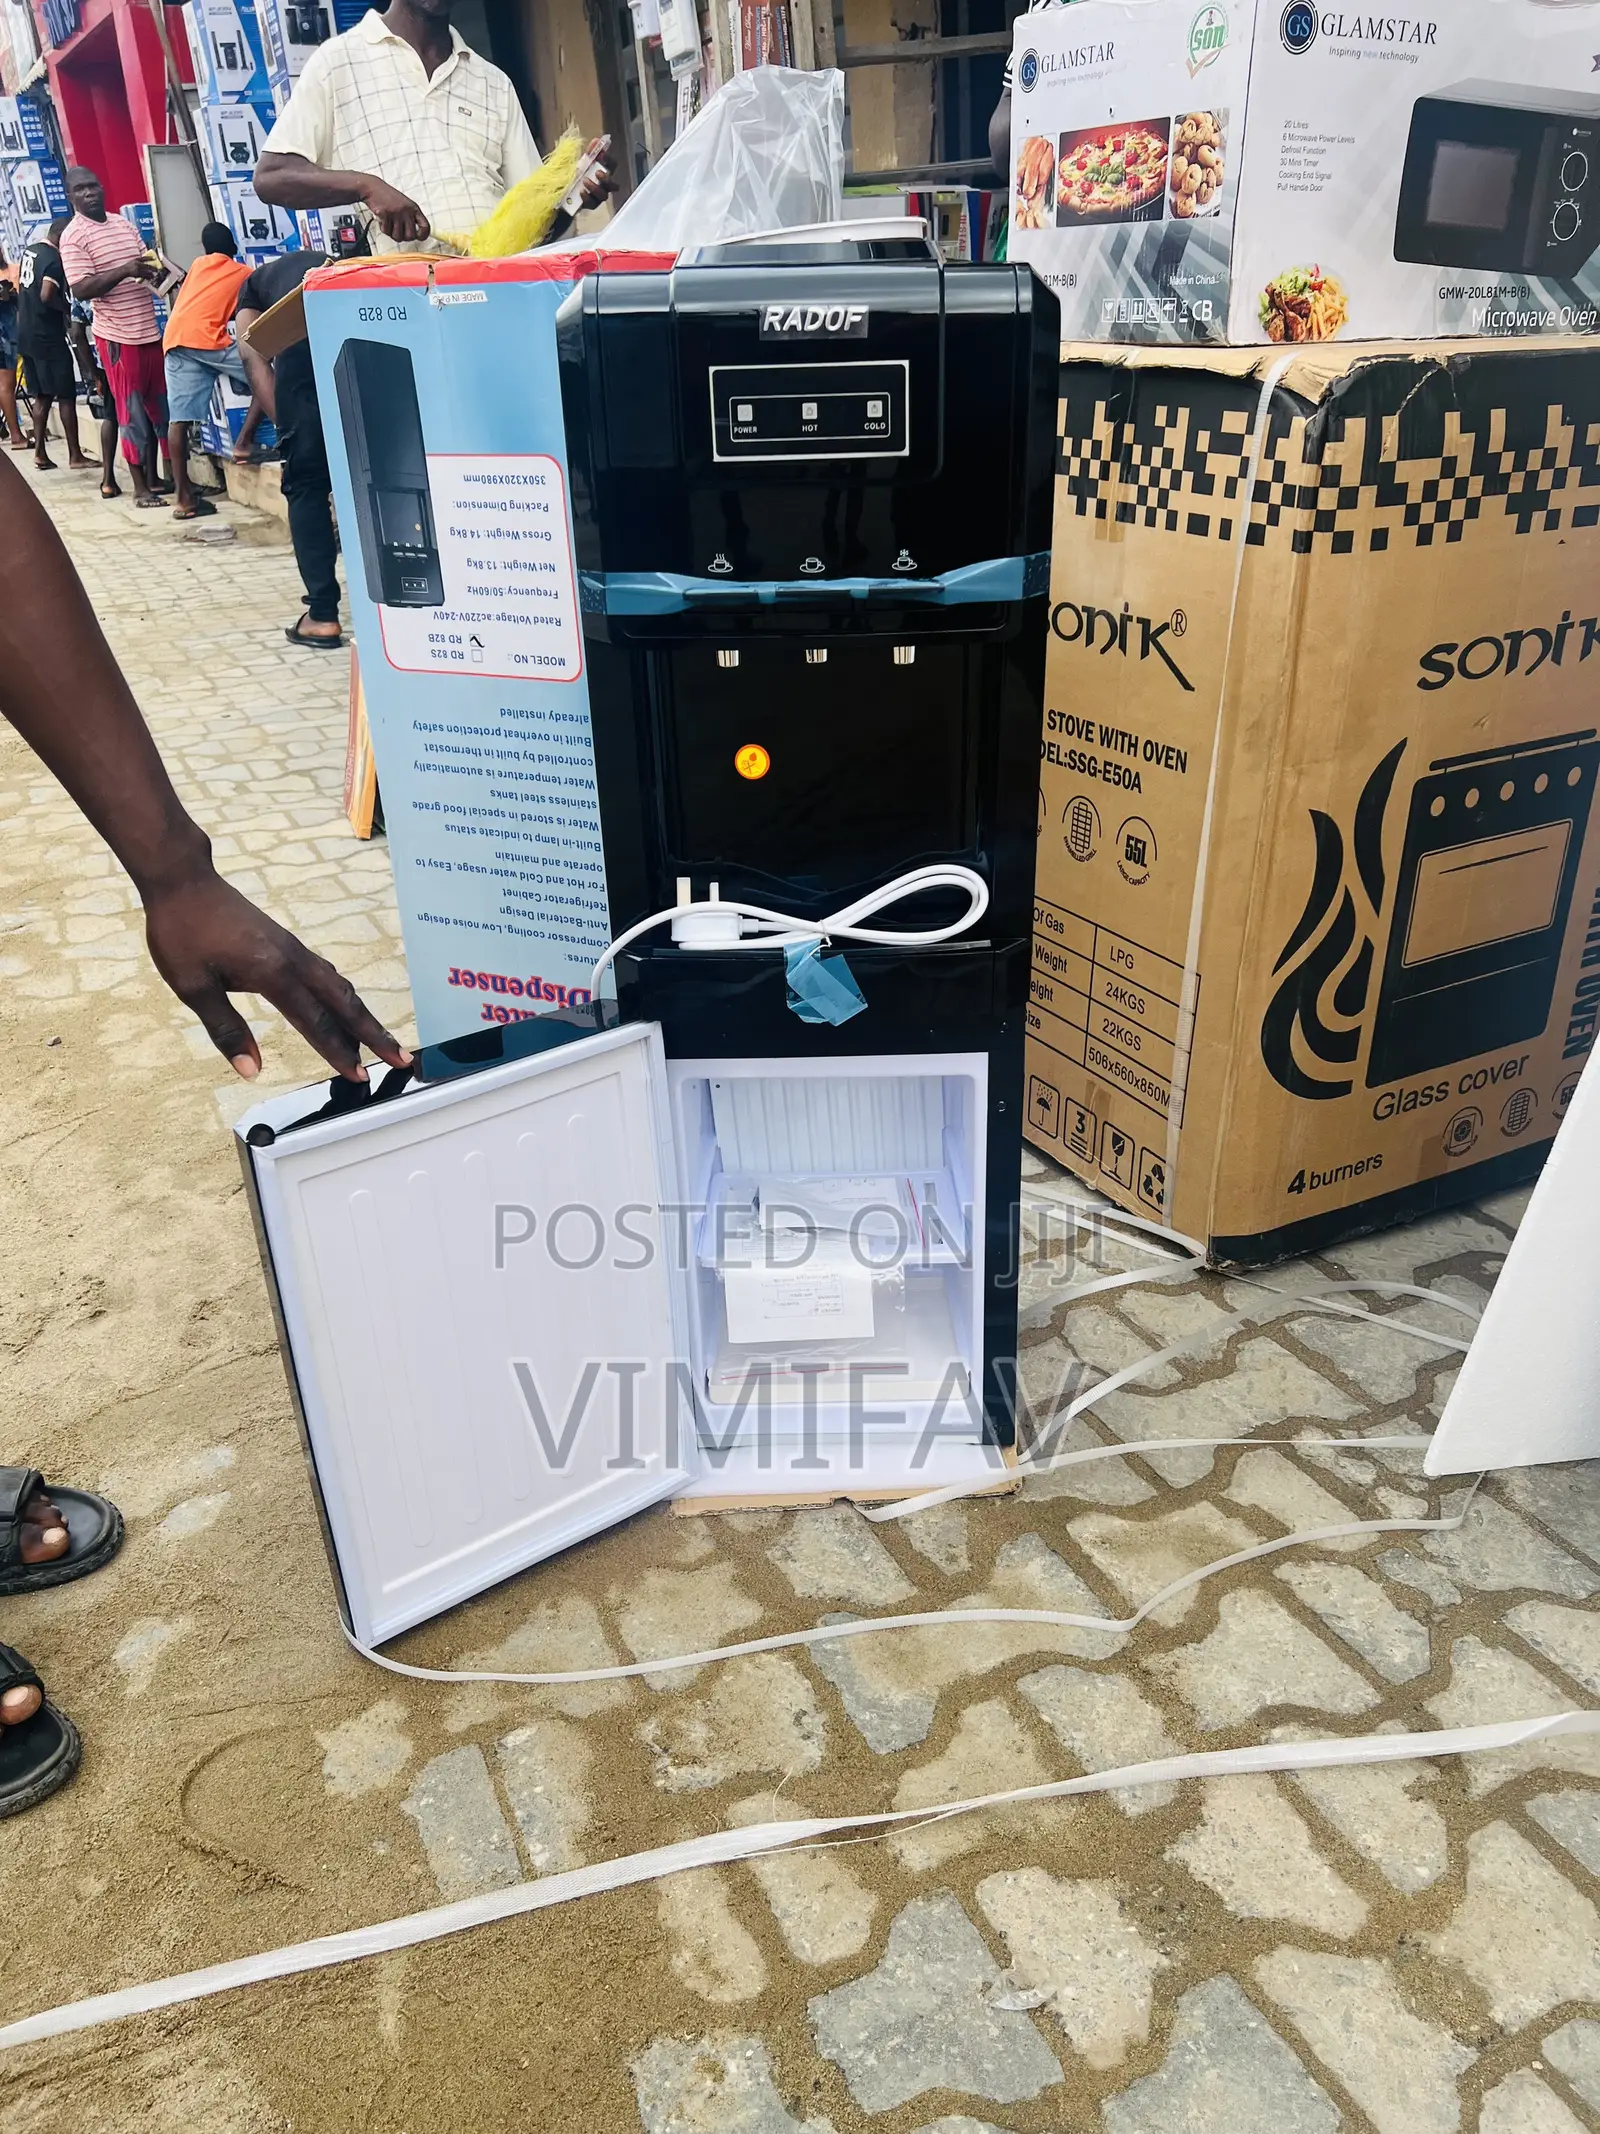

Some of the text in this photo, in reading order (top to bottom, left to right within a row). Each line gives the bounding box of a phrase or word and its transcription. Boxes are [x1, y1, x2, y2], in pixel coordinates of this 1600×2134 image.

[1321, 12, 1437, 45] GLAMSTAR
[1041, 41, 1115, 74] GLAMSTAR
[1329, 46, 1361, 59] Inspiring
[1379, 49, 1419, 64] technology
[1283, 120, 1292, 129] 20
[1282, 132, 1356, 144] 6 Microwave Power Levels
[1281, 145, 1327, 155] Defrost Function
[1280, 157, 1319, 167] 30 Mins Timer
[1278, 170, 1332, 181] Cooking End Signal
[1277, 182, 1324, 192] Pull Handle Door
[1187, 275, 1194, 284] in
[432, 293, 484, 304] MADE IN PC
[1438, 286, 1530, 300] GMW-20L81M-B(B)
[358, 306, 407, 322] RD 82B
[763, 306, 869, 332] RADOF
[1472, 306, 1597, 328] Microwave Oven
[733, 425, 758, 434] POWER
[802, 424, 819, 432] HOT
[864, 422, 886, 431] COLD
[463, 474, 546, 486] 350X320X980mm
[452, 500, 549, 513] Packing Dimension:
[484, 527, 521, 541] Weight:
[522, 531, 552, 541] Gross
[466, 558, 556, 573] Net Weight: 13.8kg
[467, 585, 559, 600] Frequency:50/60Hz
[533, 616, 562, 627] Rated
[428, 633, 463, 644] RD 82B
[430, 649, 448, 659] 82S
[450, 650, 465, 660] RD
[530, 655, 566, 667] MODEL
[499, 707, 590, 724] already installed
[412, 719, 592, 748] Built in overheat protection safety
[1046, 708, 1188, 774] STOVE WITH OVEN
[423, 743, 594, 767] controlled by built in thermostat
[413, 760, 596, 790] Water temperature is automatically
[489, 789, 598, 809] stainless steel tanks
[412, 801, 599, 832] Water is stored in special food grade
[444, 823, 602, 852] Built-in lamp to indicate status
[1125, 833, 1148, 869] 55L
[415, 858, 426, 868] to
[428, 859, 452, 872] Easy
[495, 851, 603, 873] operate and maintain
[489, 868, 518, 879] water
[520, 871, 543, 884] Cold
[1117, 859, 1151, 886] LARGE CAPACITY
[545, 875, 565, 886] and
[567, 878, 585, 890] Hot
[588, 882, 605, 893] For
[502, 887, 608, 912] Refrigerator Cabinet
[417, 912, 451, 926] design
[452, 918, 480, 930] noise
[499, 906, 608, 931] Anti-Bacterial Design
[481, 921, 503, 934] Low
[547, 932, 611, 950] Compressor
[1032, 907, 1135, 970] Of Gas LPG
[563, 953, 613, 970] Fatures:
[1034, 943, 1146, 1015] Weight 24KGS
[447, 966, 592, 1010] Dispenser
[1030, 978, 1142, 1052] eight 22KGS
[1088, 1047, 1171, 1109] 506x560x850M
[1372, 1081, 1450, 1122] Glass
[1457, 1051, 1530, 1099] cover
